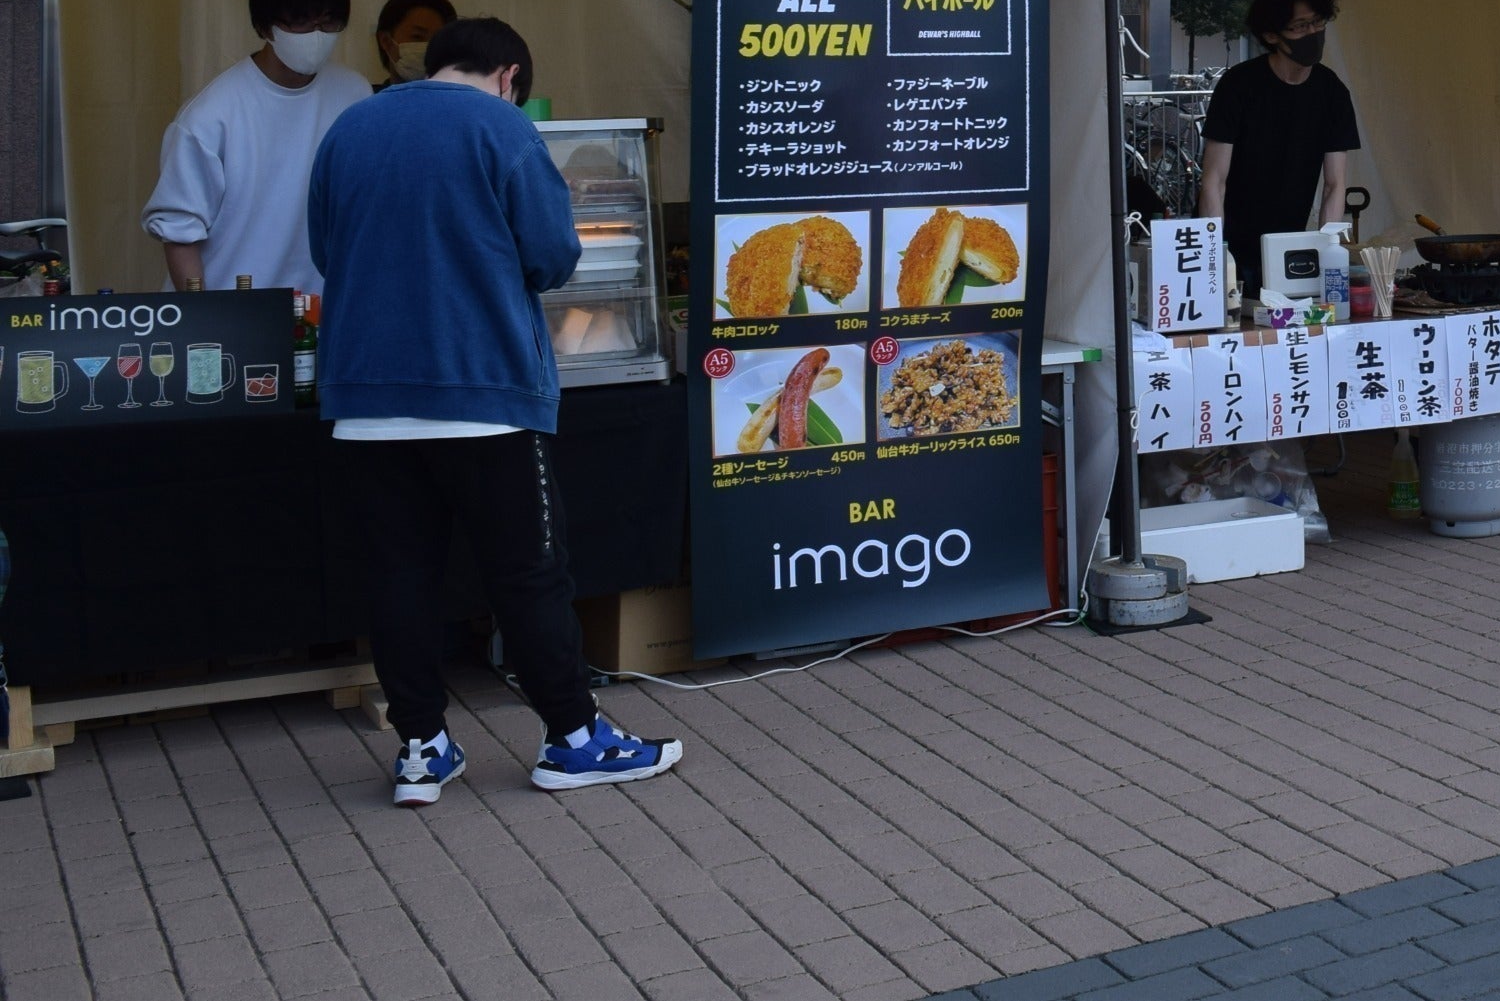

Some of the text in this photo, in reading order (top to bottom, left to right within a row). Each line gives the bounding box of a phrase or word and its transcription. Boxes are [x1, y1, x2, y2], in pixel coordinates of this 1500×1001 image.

[738, 24, 872, 57] 500YEN
[746, 79, 821, 93] ジントニック
[894, 77, 988, 90] ファジーネーブル
[746, 100, 824, 114] カシスソーダ
[894, 98, 968, 111] レゲエパンチ
[746, 120, 836, 135] カシスオレンジ
[893, 117, 1008, 131] カンフォートトニック
[746, 141, 846, 156] テキーラショット
[893, 136, 1010, 151] カンフォートオレンジ
[1175, 227, 1203, 322] 生ビール
[1208, 234, 1217, 294] サッポロ黒ラベル
[880, 307, 1023, 327] コクうまチーズ 200円
[1158, 285, 1171, 328] 500円
[11, 304, 182, 336] BAR imago
[712, 319, 868, 338] 牛肉コロッケ 180円
[709, 352, 728, 366] A5
[876, 340, 893, 353] A5
[1356, 342, 1388, 399] 生茶
[1413, 324, 1441, 417] ウーロン茶
[1221, 338, 1243, 441] ウーロンハイ
[1453, 378, 1464, 416] 700円
[1199, 401, 1212, 444] 500円
[1272, 393, 1283, 436] 500円
[877, 434, 1020, 459] 仙台牛ガーリックライス 650円
[713, 450, 865, 476] 2種ソーセージ 450円
[849, 499, 896, 523] BAR
[773, 528, 971, 590] imago
